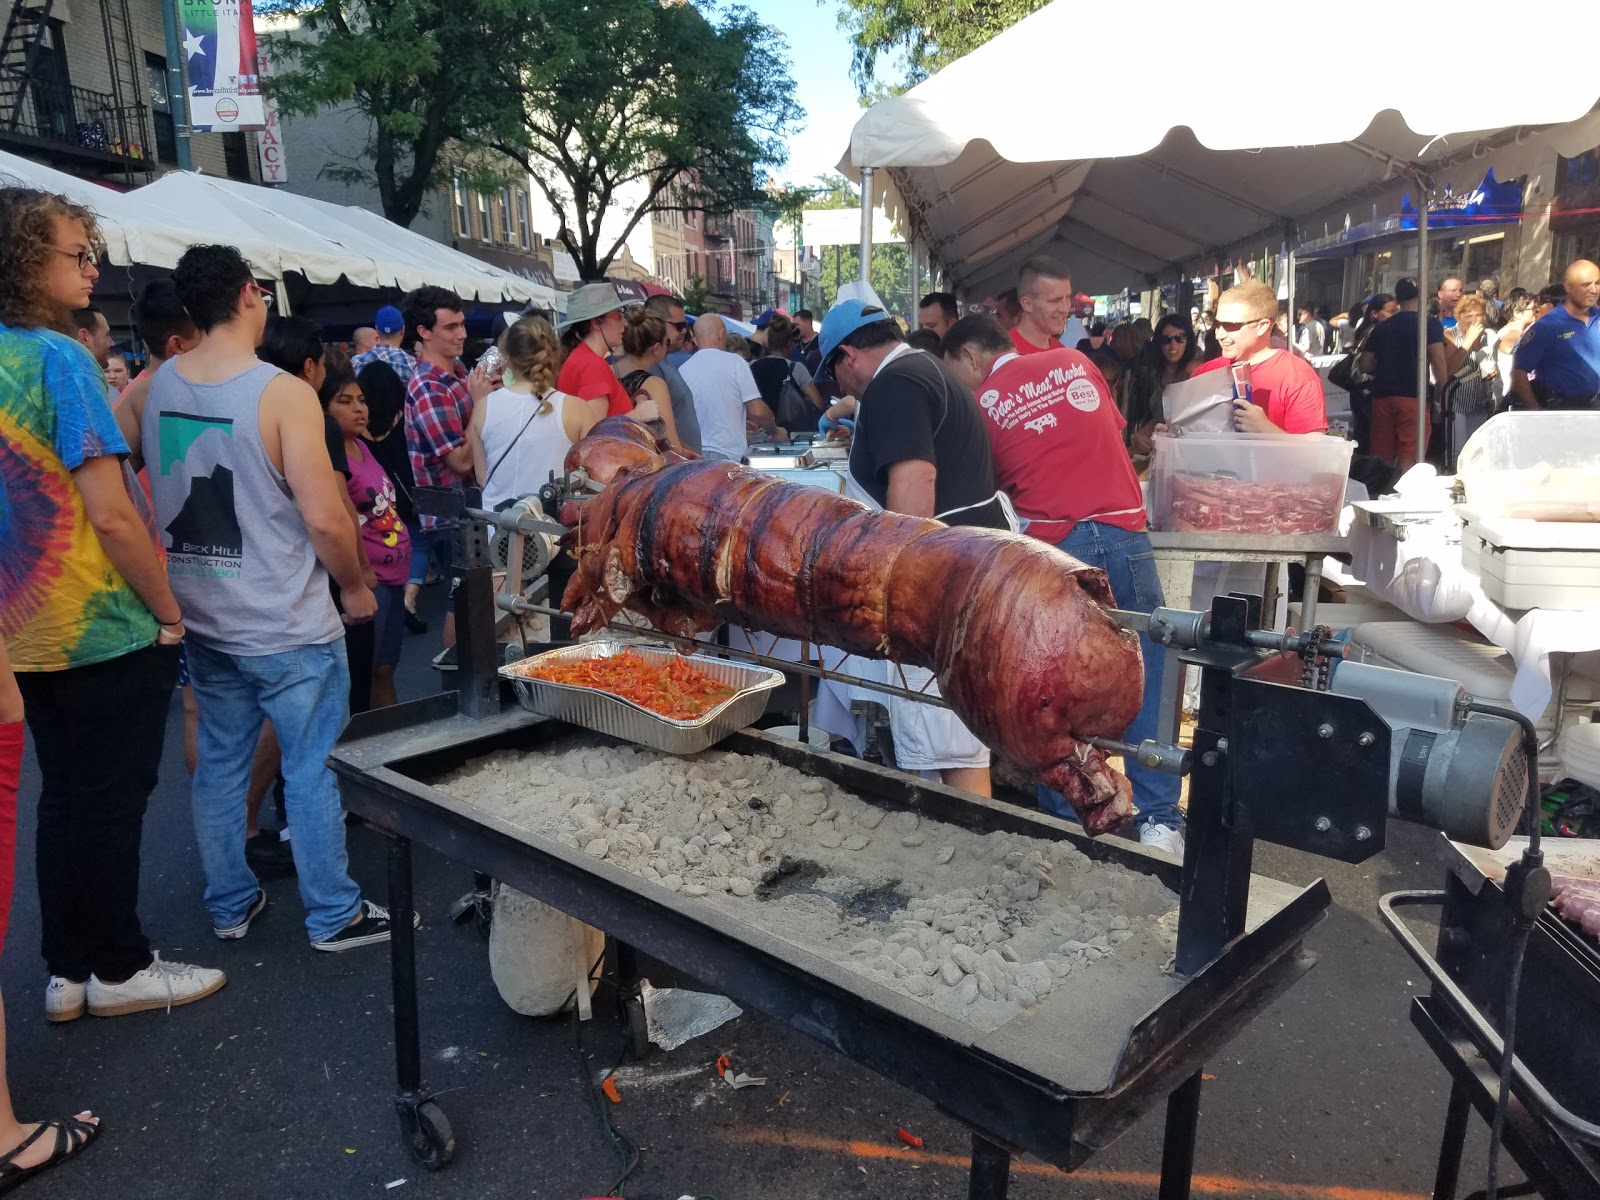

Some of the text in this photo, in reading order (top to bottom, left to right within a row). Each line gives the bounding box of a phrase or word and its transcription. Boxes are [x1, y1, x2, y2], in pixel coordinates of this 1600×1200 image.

[185, 9, 219, 17] LITTLE
[988, 363, 1086, 425] Peter's Meat Market
[1071, 389, 1096, 401] Best
[1018, 410, 1032, 421] Italy
[212, 545, 242, 557] HILL
